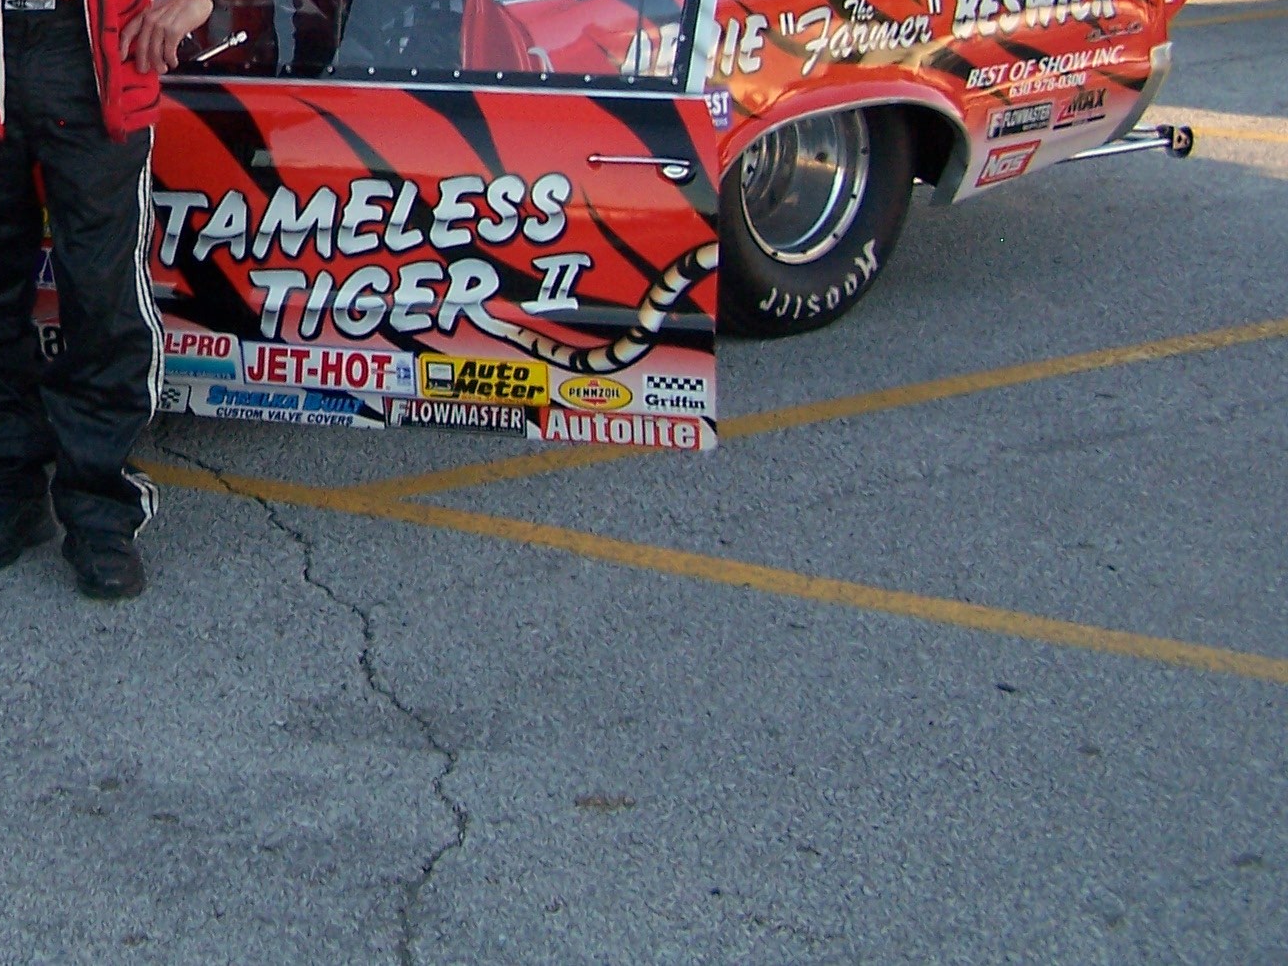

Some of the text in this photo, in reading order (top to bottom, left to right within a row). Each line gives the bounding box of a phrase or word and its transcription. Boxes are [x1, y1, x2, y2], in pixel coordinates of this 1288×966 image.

[966, 44, 1125, 89] BEST OF SHOW INC.
[152, 174, 572, 266] TAMELESS
[250, 252, 591, 338] TIGER II
[247, 346, 393, 390] JET-HOT
[459, 361, 530, 381] Auto
[454, 378, 544, 399] Meter
[568, 386, 621, 399] PENNZOIL
[645, 394, 705, 410] Griffin
[216, 407, 354, 426] CUSTOM VALVE COVERS
[389, 398, 523, 431] FLOWMASTER
[546, 410, 699, 450] Autolite
